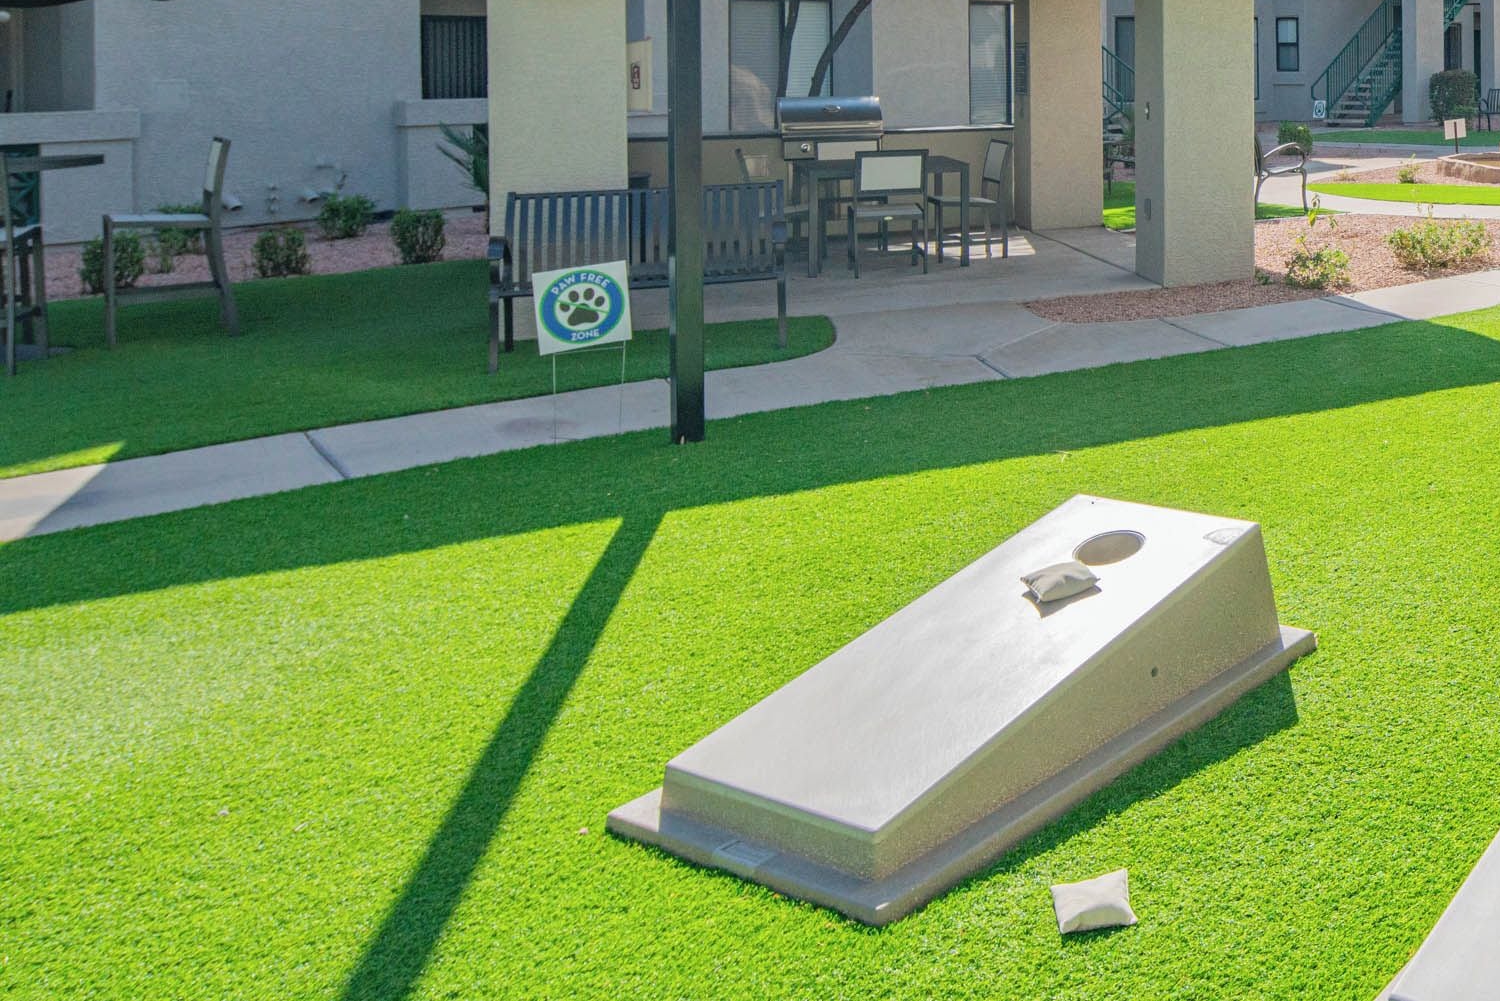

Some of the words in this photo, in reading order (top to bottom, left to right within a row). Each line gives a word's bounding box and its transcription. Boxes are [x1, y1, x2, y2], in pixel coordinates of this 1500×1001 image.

[551, 275, 576, 295] PAW
[580, 272, 610, 287] FREE
[571, 328, 600, 341] ZONE
